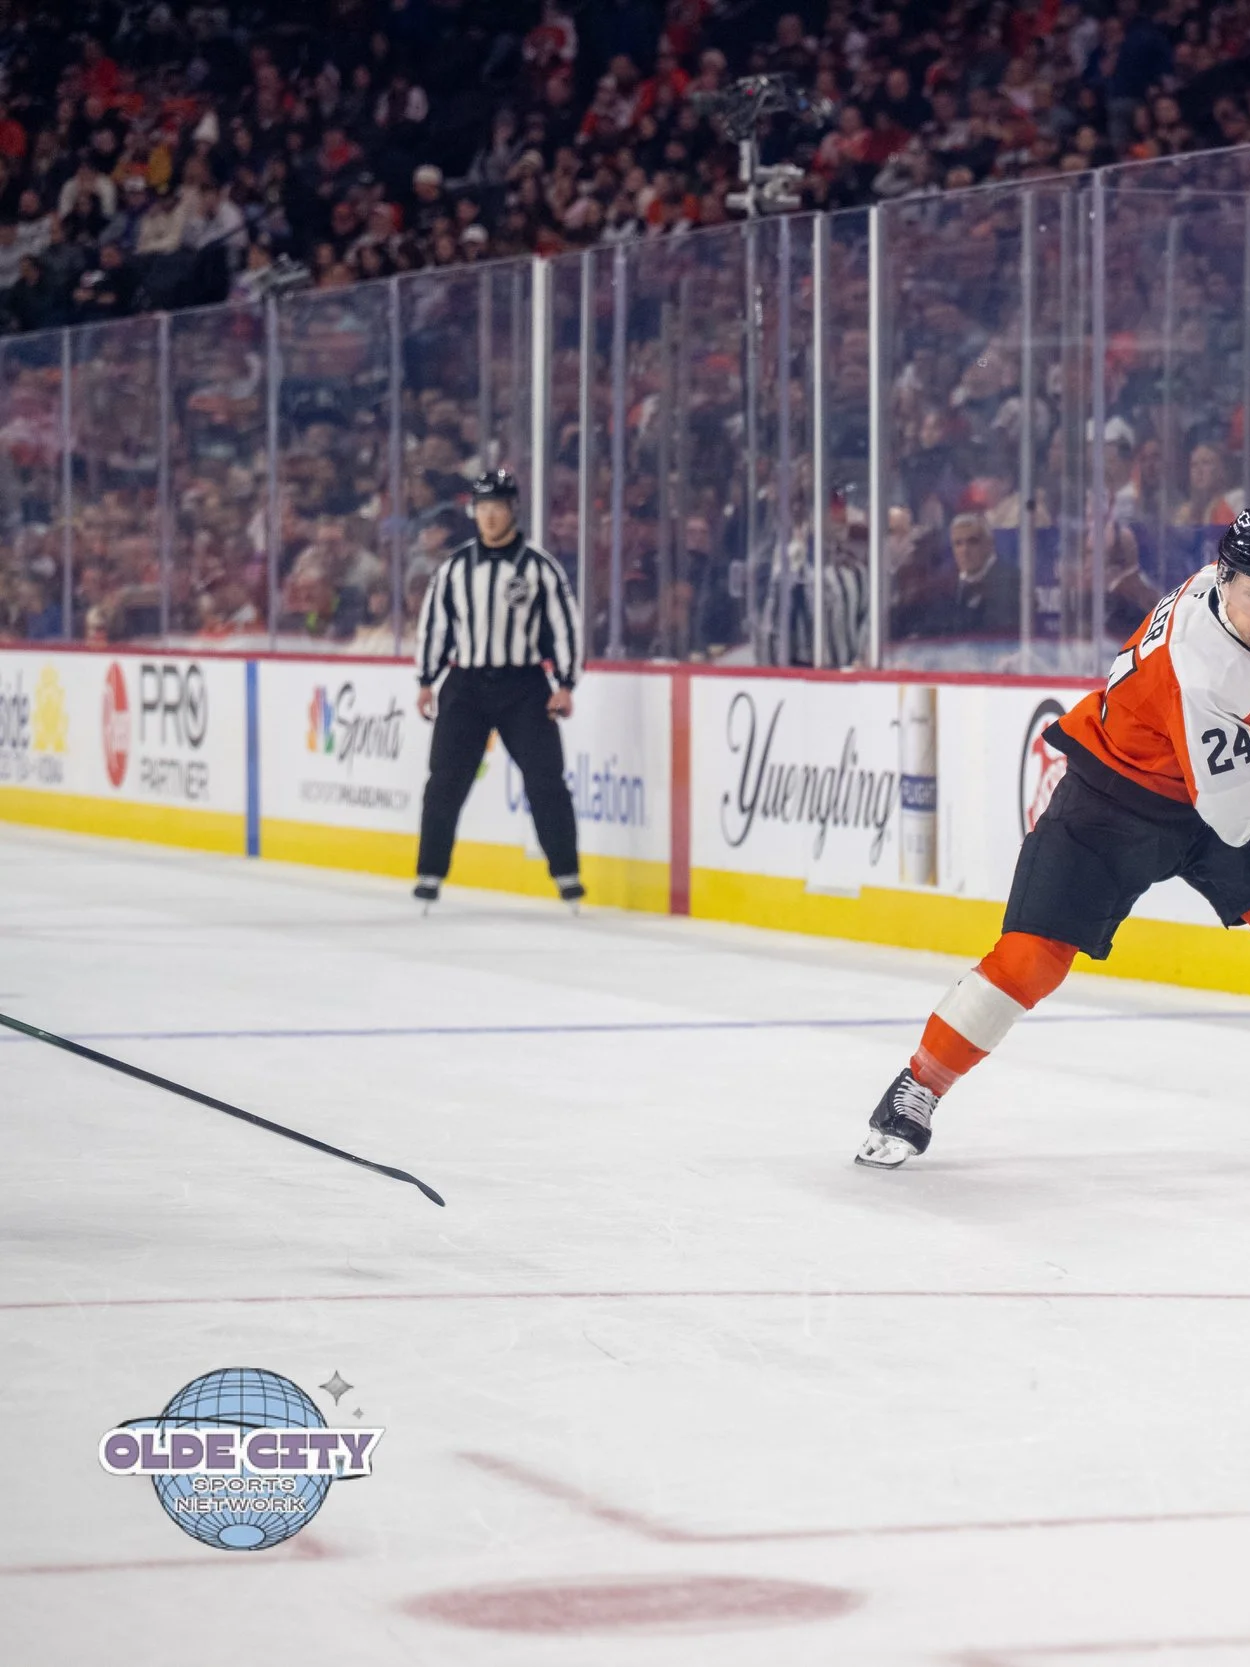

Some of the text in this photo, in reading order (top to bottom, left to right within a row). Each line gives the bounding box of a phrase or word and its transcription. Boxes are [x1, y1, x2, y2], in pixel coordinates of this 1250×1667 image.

[140, 664, 208, 748] PRO
[336, 681, 405, 778] Sports
[720, 691, 896, 867] Yuengling
